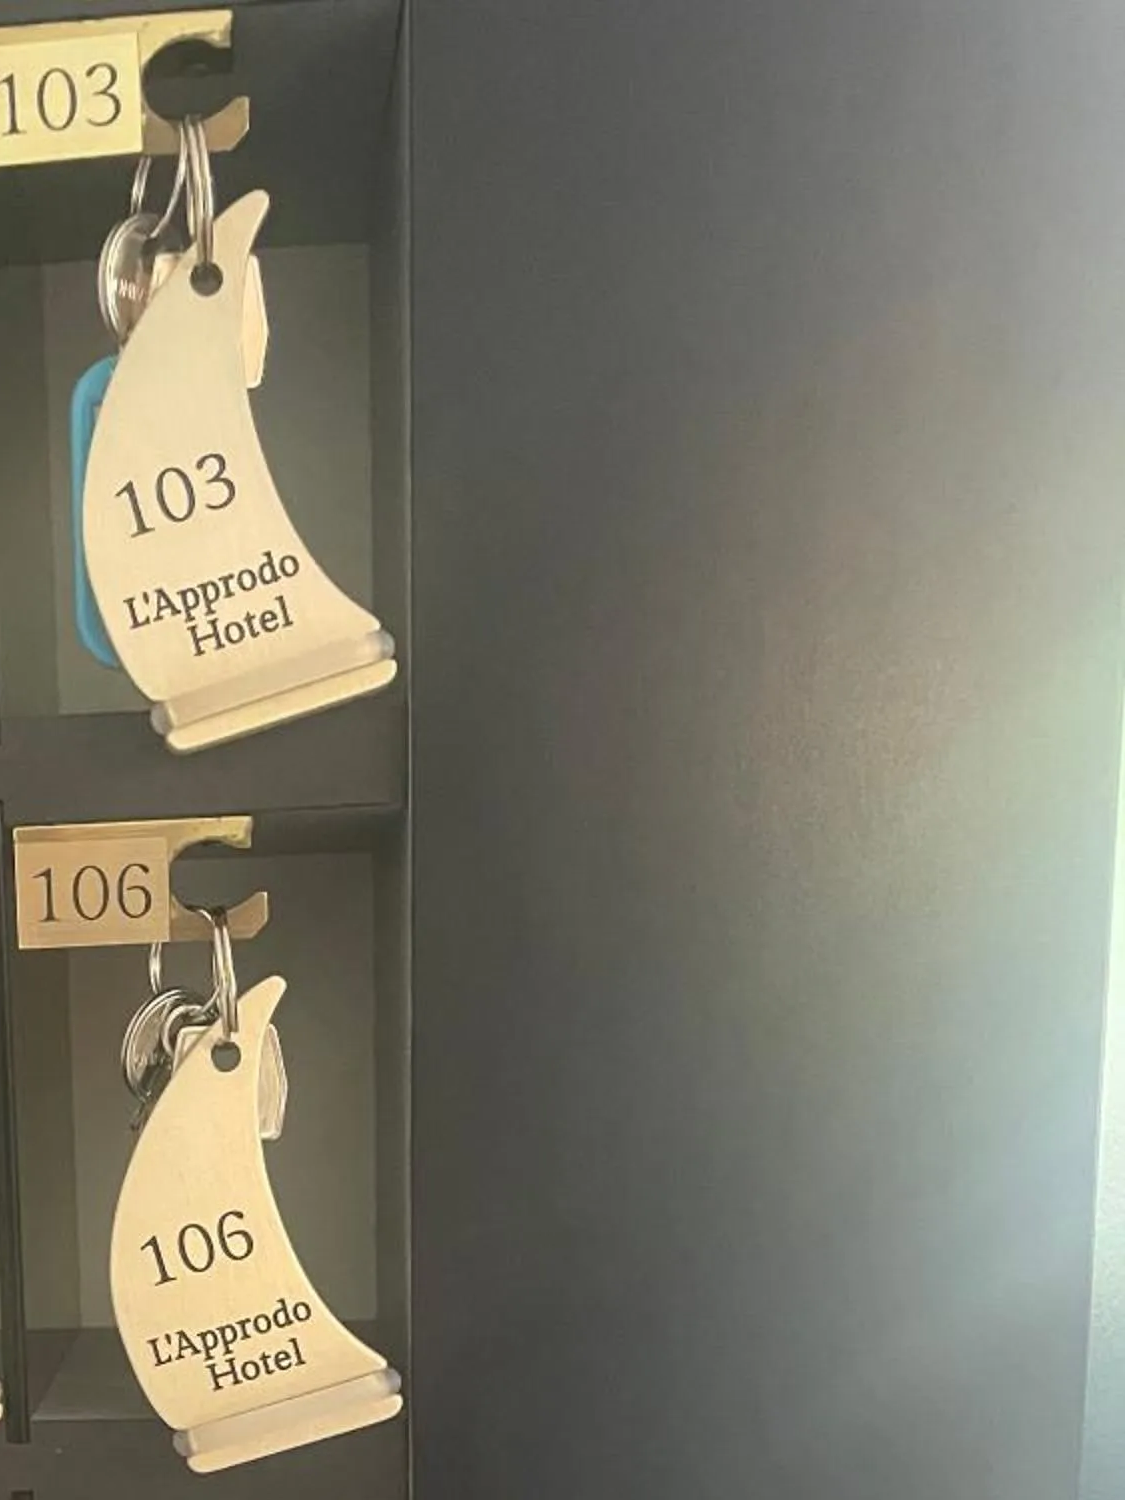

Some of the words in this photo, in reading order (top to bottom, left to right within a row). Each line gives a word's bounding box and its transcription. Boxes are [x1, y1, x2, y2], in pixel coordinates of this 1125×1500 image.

[114, 453, 236, 538] 103
[122, 550, 300, 630] L'Approdo
[186, 594, 294, 657] Hotel
[32, 863, 152, 923] 106
[140, 1210, 254, 1287] 106
[146, 1297, 312, 1367] L'Approdo
[205, 1337, 307, 1392] Hotel
